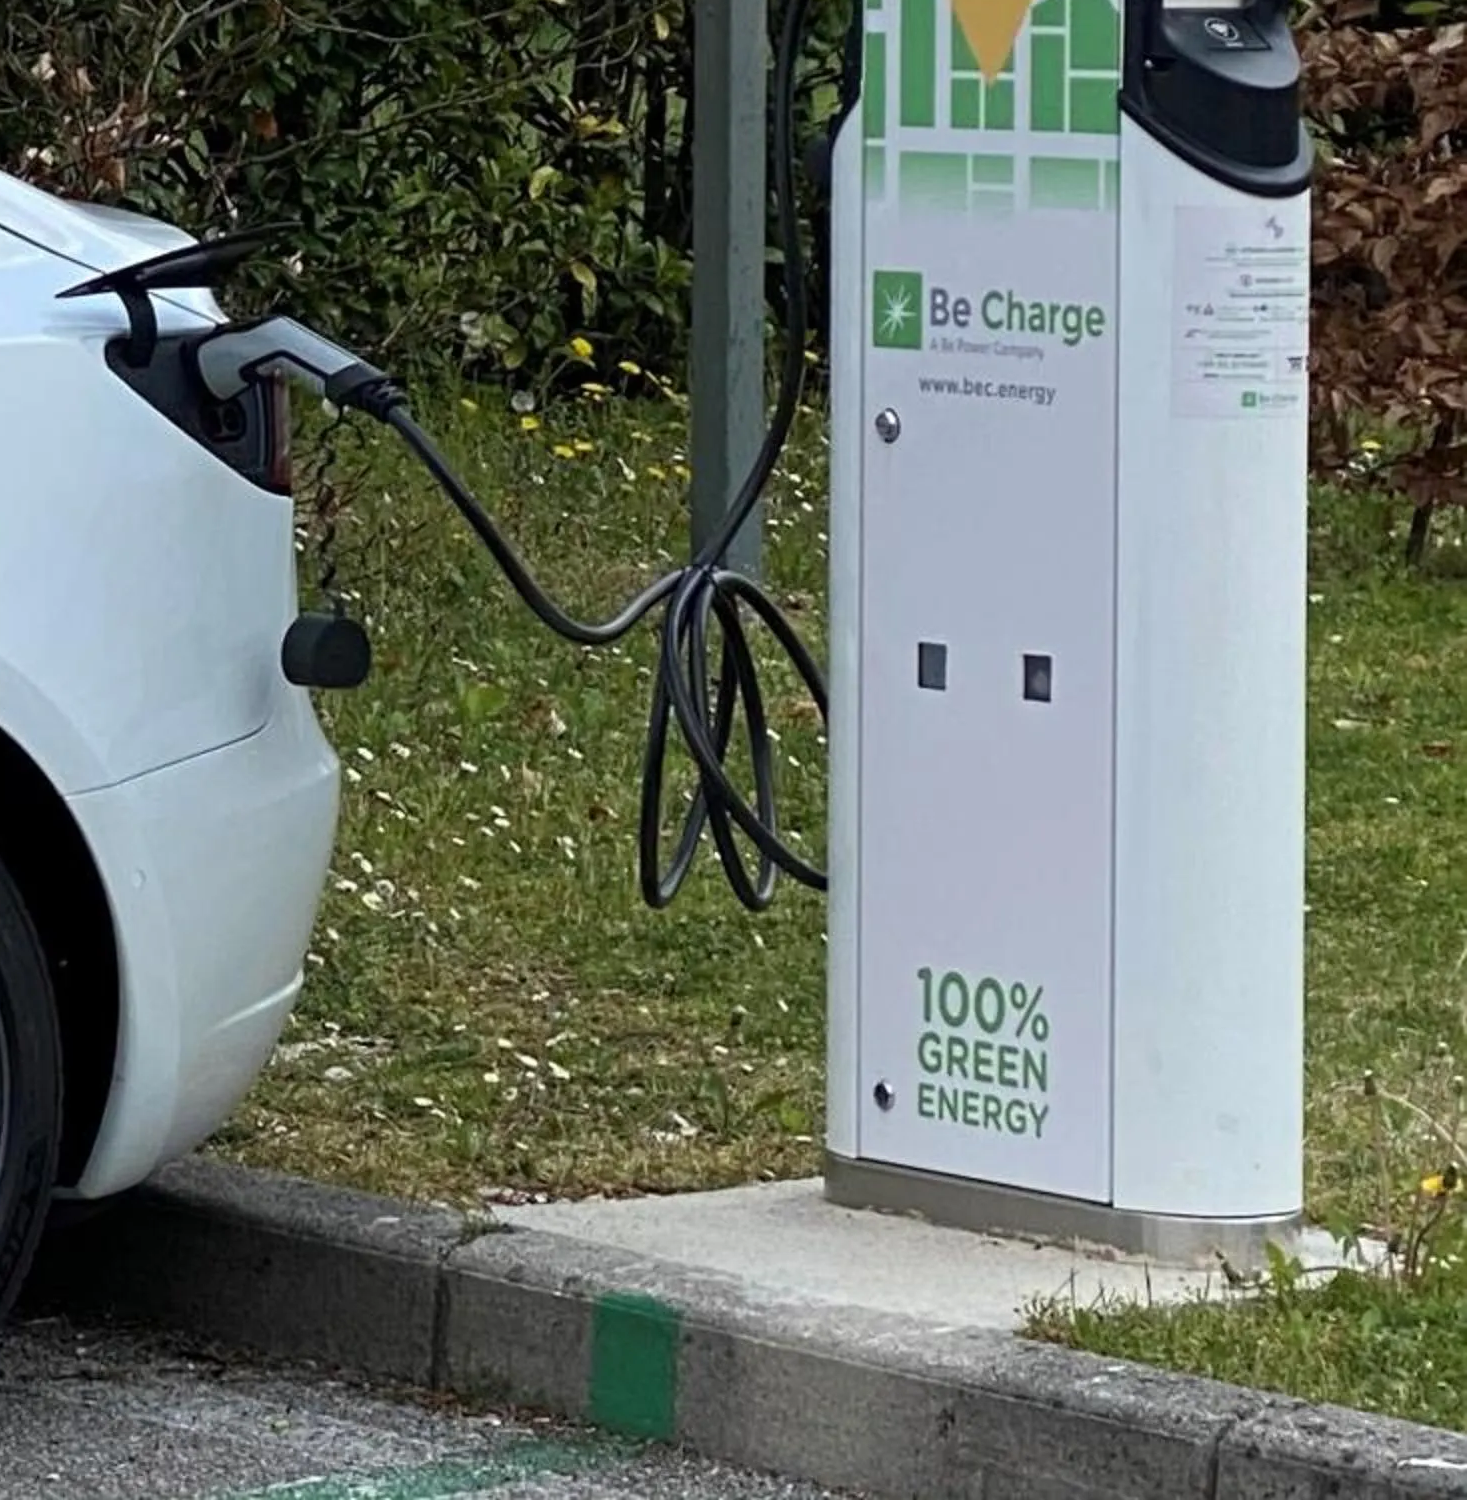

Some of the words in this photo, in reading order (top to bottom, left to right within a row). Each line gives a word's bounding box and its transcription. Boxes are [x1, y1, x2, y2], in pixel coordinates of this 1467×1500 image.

[930, 287, 971, 328] Be
[982, 289, 1105, 347] Charge
[918, 375, 1056, 406] www.bec.energy
[917, 966, 1049, 1042] 100%
[918, 1031, 1048, 1093] GREEN
[918, 1082, 1049, 1139] ENERGY
